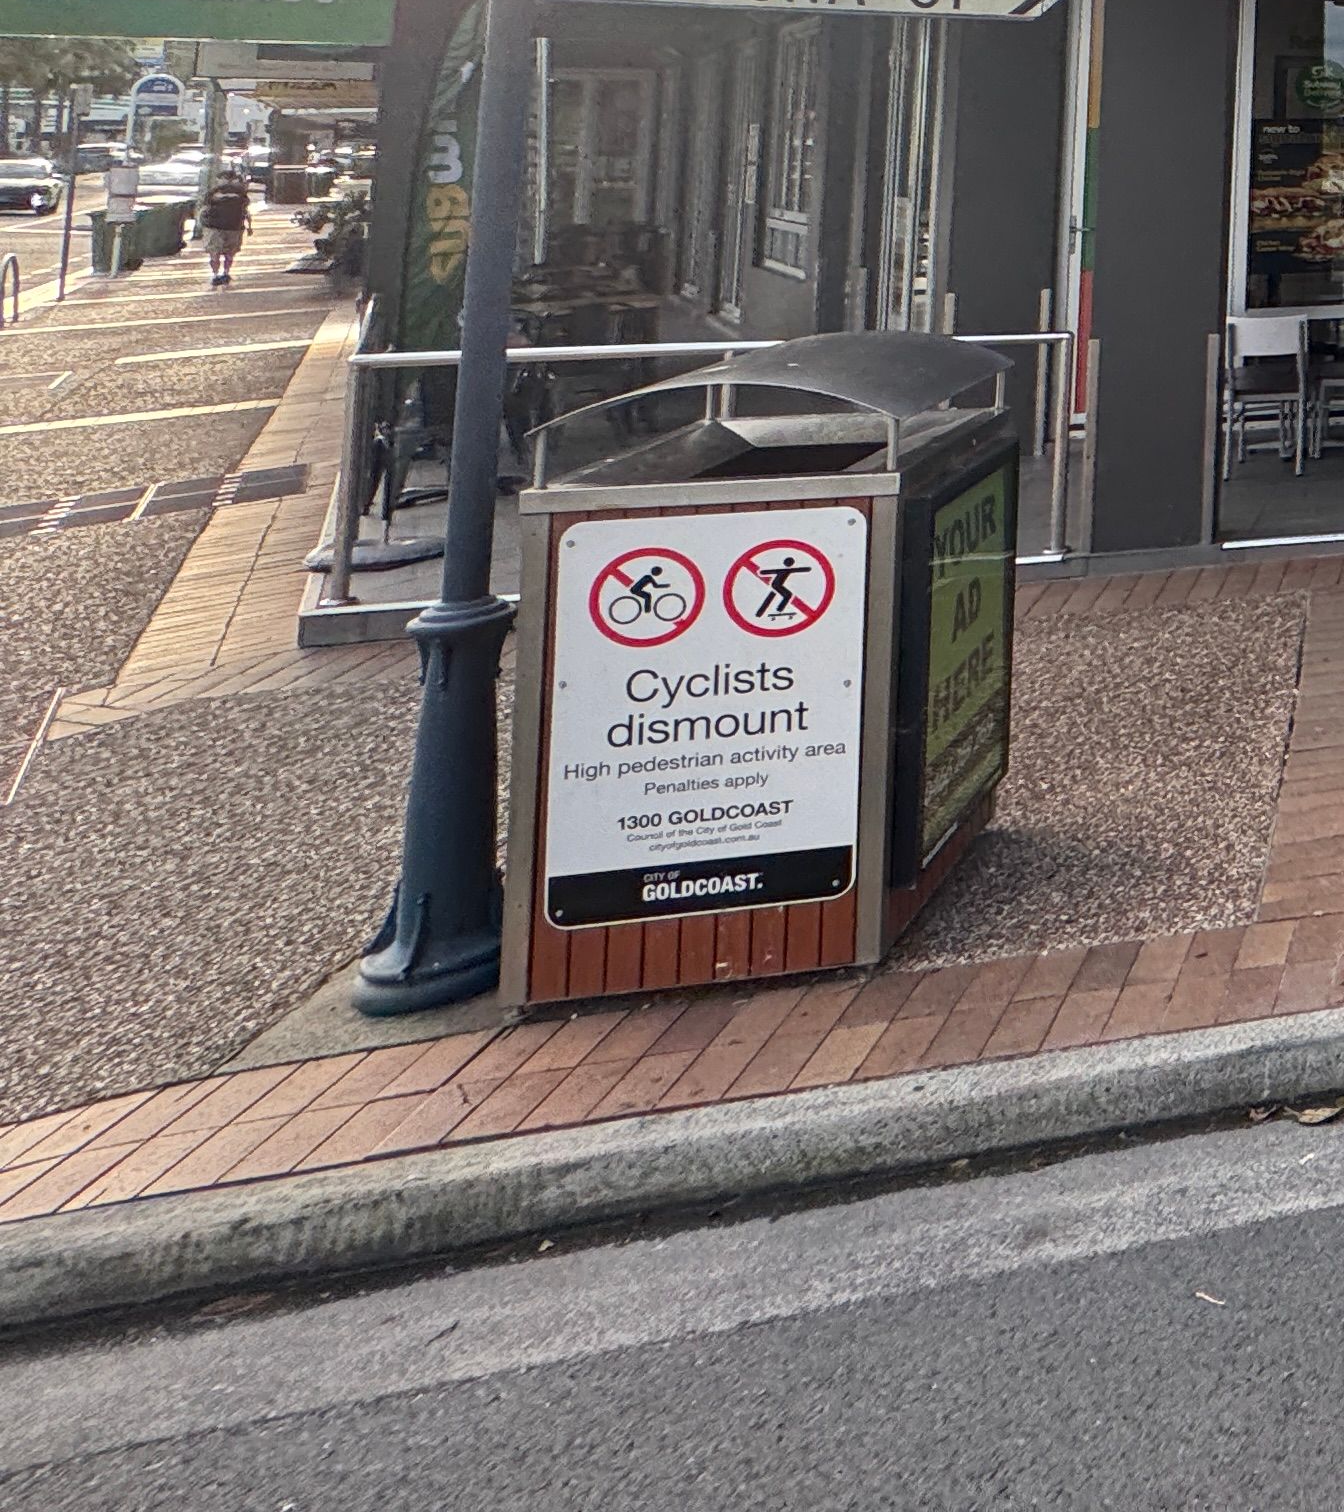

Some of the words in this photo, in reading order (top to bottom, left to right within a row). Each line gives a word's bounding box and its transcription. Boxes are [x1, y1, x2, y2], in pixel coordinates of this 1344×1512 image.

[625, 661, 794, 709] Cyclists
[606, 701, 809, 748] dismount
[563, 763, 611, 781] High
[617, 751, 724, 777] pedestrian
[730, 744, 799, 765] activity
[804, 741, 847, 758] area
[643, 776, 720, 796] Penalties
[724, 772, 769, 790] apply
[616, 812, 663, 831] 1300
[668, 800, 794, 826] GOLDCOAST
[678, 828, 693, 837] the
[696, 826, 715, 836] City
[729, 822, 752, 832] Gold
[754, 819, 782, 830] Coast
[643, 872, 666, 883] CITY
